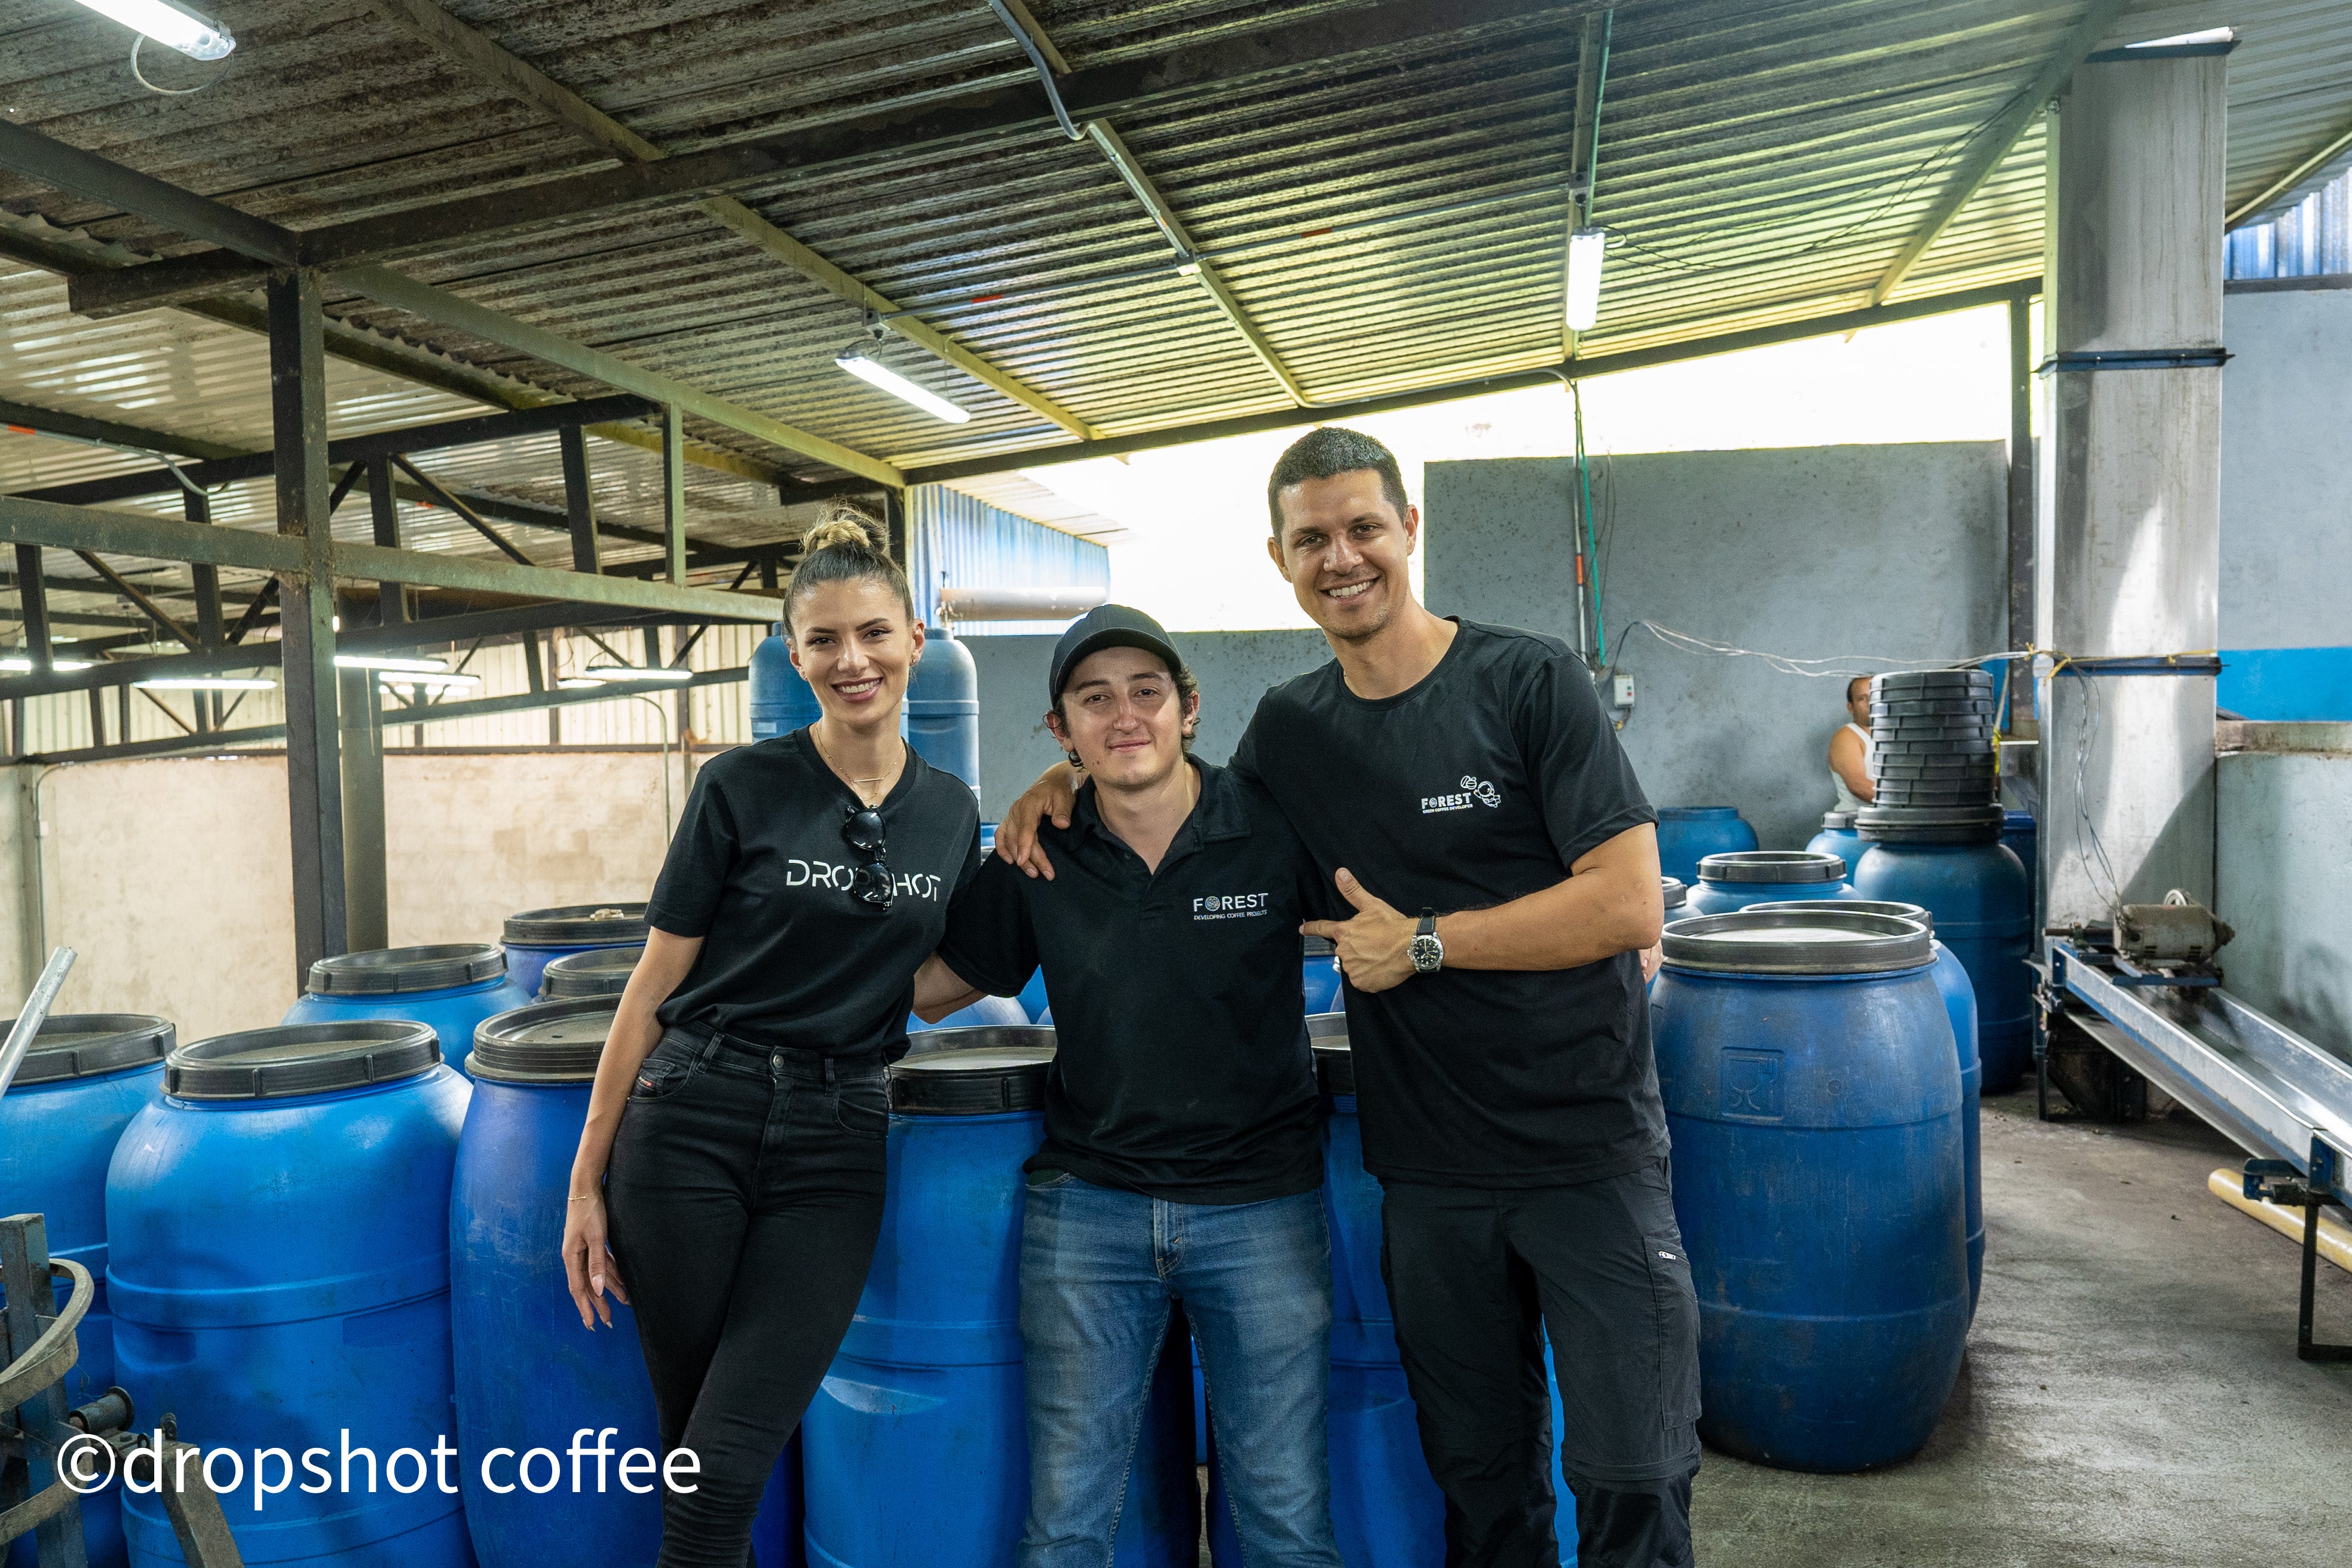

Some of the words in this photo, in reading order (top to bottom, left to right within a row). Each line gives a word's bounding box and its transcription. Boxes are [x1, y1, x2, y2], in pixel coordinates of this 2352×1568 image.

[1421, 792, 1472, 809] FOREST
[786, 859, 941, 902] DROHOT
[1193, 893, 1269, 912] FOREST
